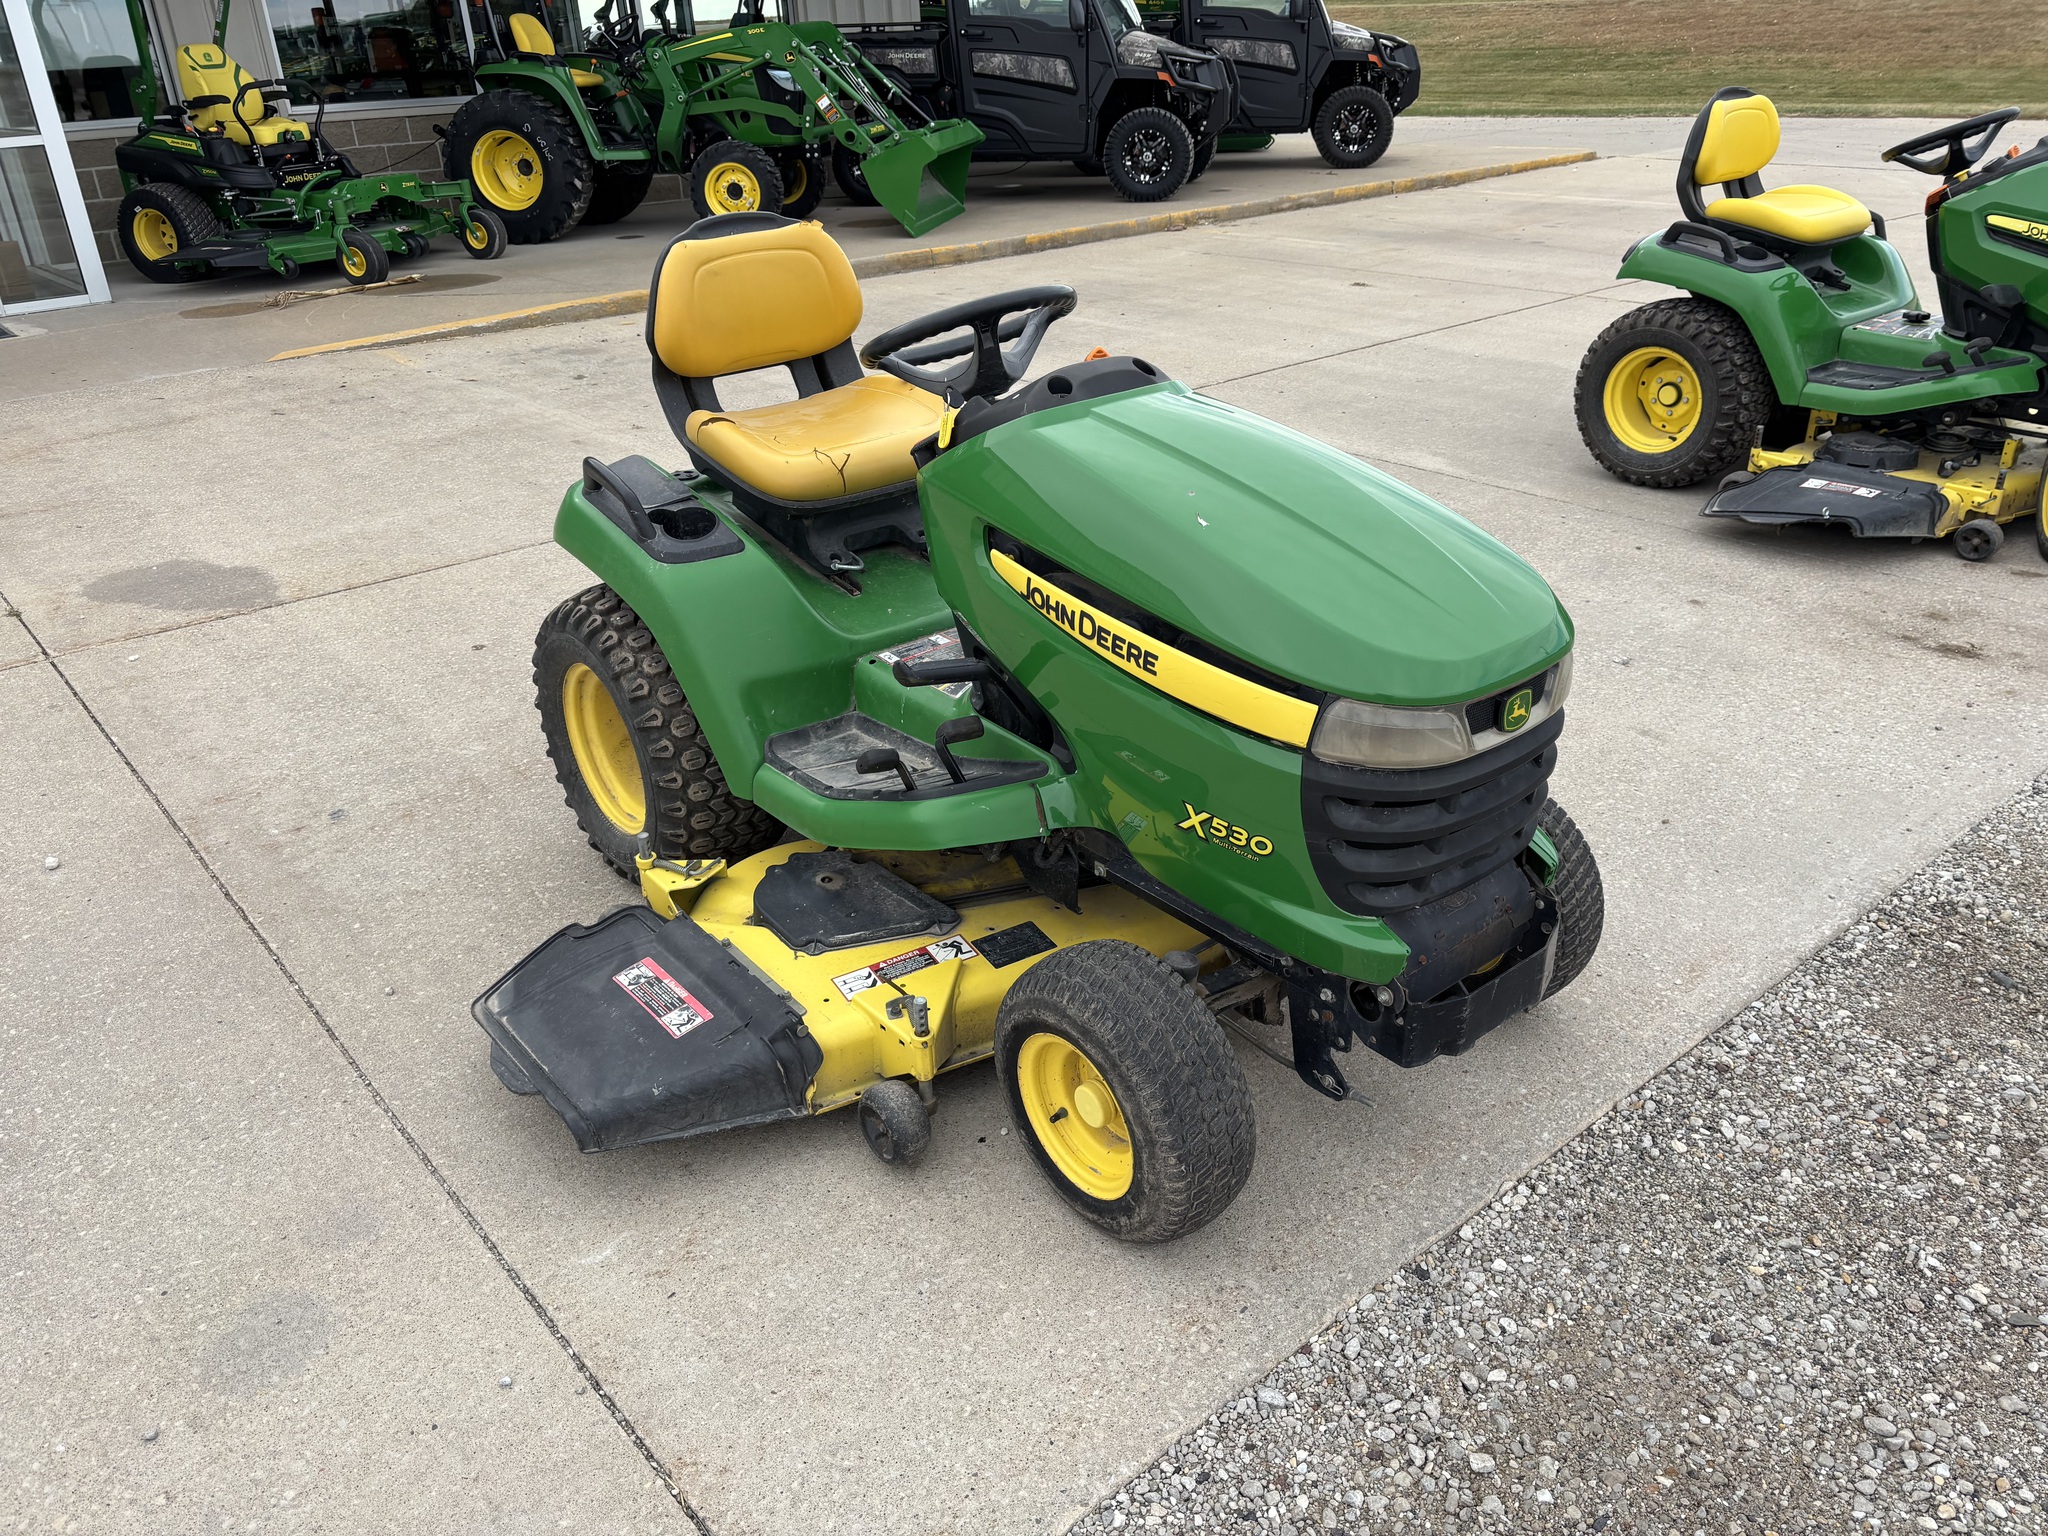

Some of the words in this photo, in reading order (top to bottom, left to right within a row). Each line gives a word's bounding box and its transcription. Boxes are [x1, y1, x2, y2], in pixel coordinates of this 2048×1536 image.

[285, 174, 303, 183] JOHN
[1020, 576, 1075, 631] JOHN
[1079, 610, 1159, 677] DEERE
[1175, 801, 1274, 856] X530
[1213, 838, 1260, 862] Multi-Terrain
[886, 950, 920, 965] DANGER
